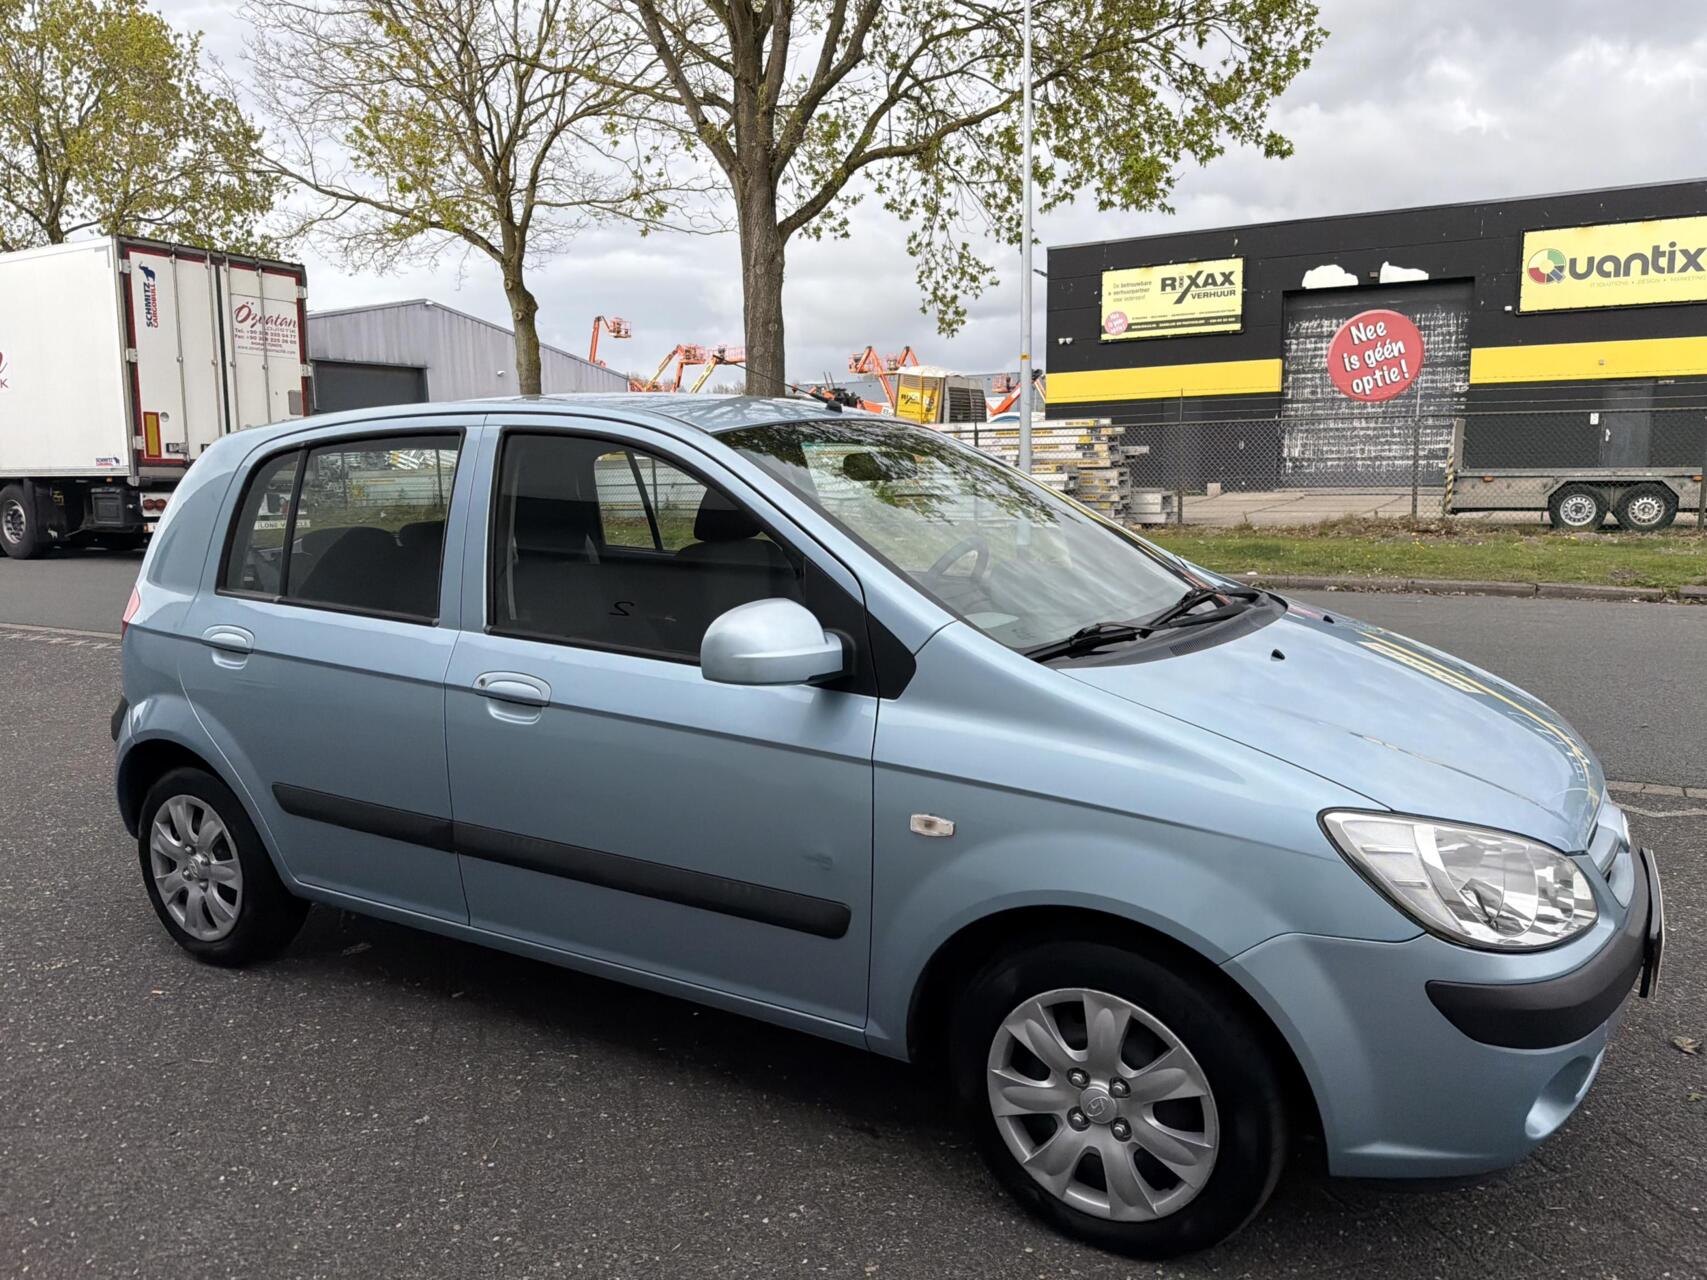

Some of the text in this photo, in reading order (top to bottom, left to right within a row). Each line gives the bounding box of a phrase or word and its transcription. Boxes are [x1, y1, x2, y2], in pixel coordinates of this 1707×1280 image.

[1527, 241, 1707, 285] Quantix
[143, 281, 154, 329] SCHMITZ
[1190, 289, 1236, 300] VERHUUR
[1349, 321, 1387, 345] Nee
[1343, 339, 1406, 372] is géén
